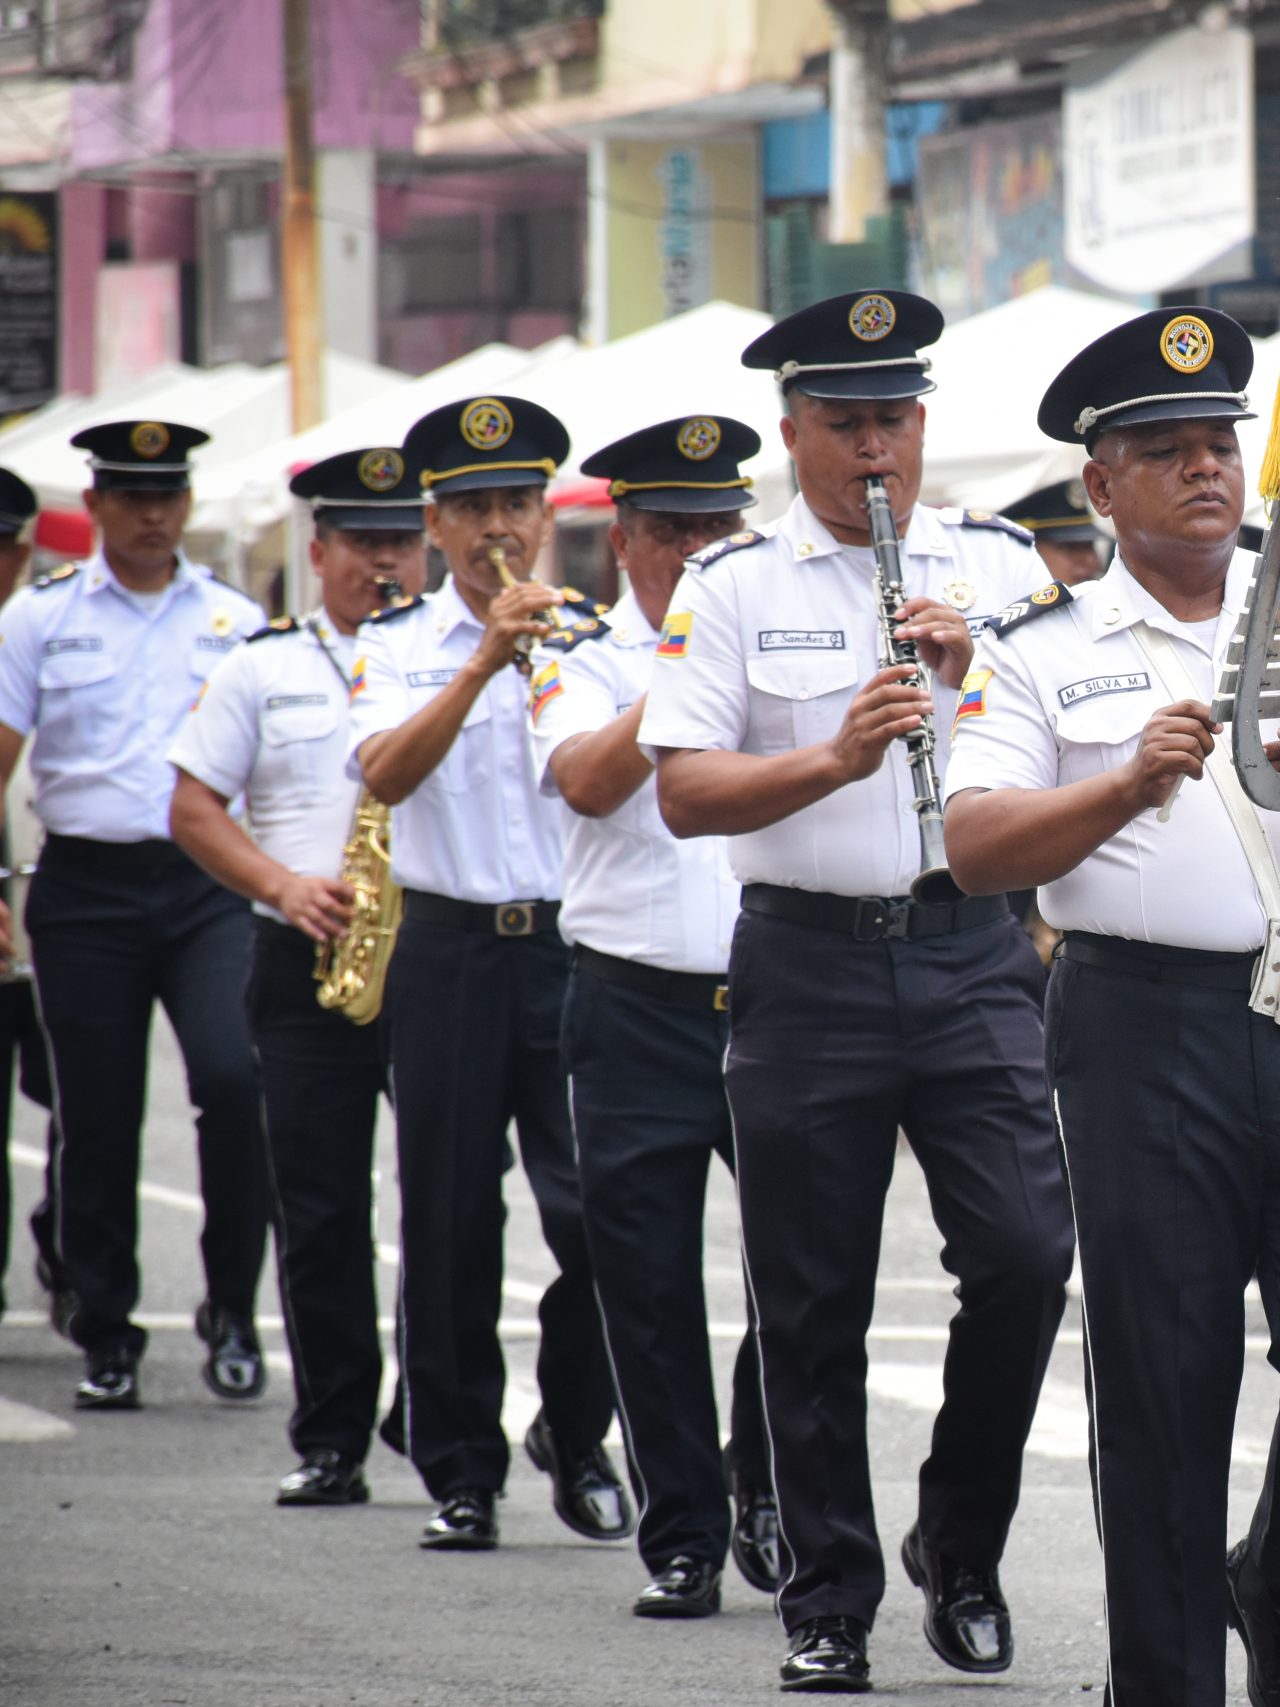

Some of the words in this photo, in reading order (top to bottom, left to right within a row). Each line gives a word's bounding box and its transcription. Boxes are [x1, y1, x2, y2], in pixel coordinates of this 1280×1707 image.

[780, 632, 825, 644] Sanchez
[1065, 688, 1080, 701] M.
[1085, 679, 1122, 693] SILVA
[1128, 677, 1142, 686] M.
